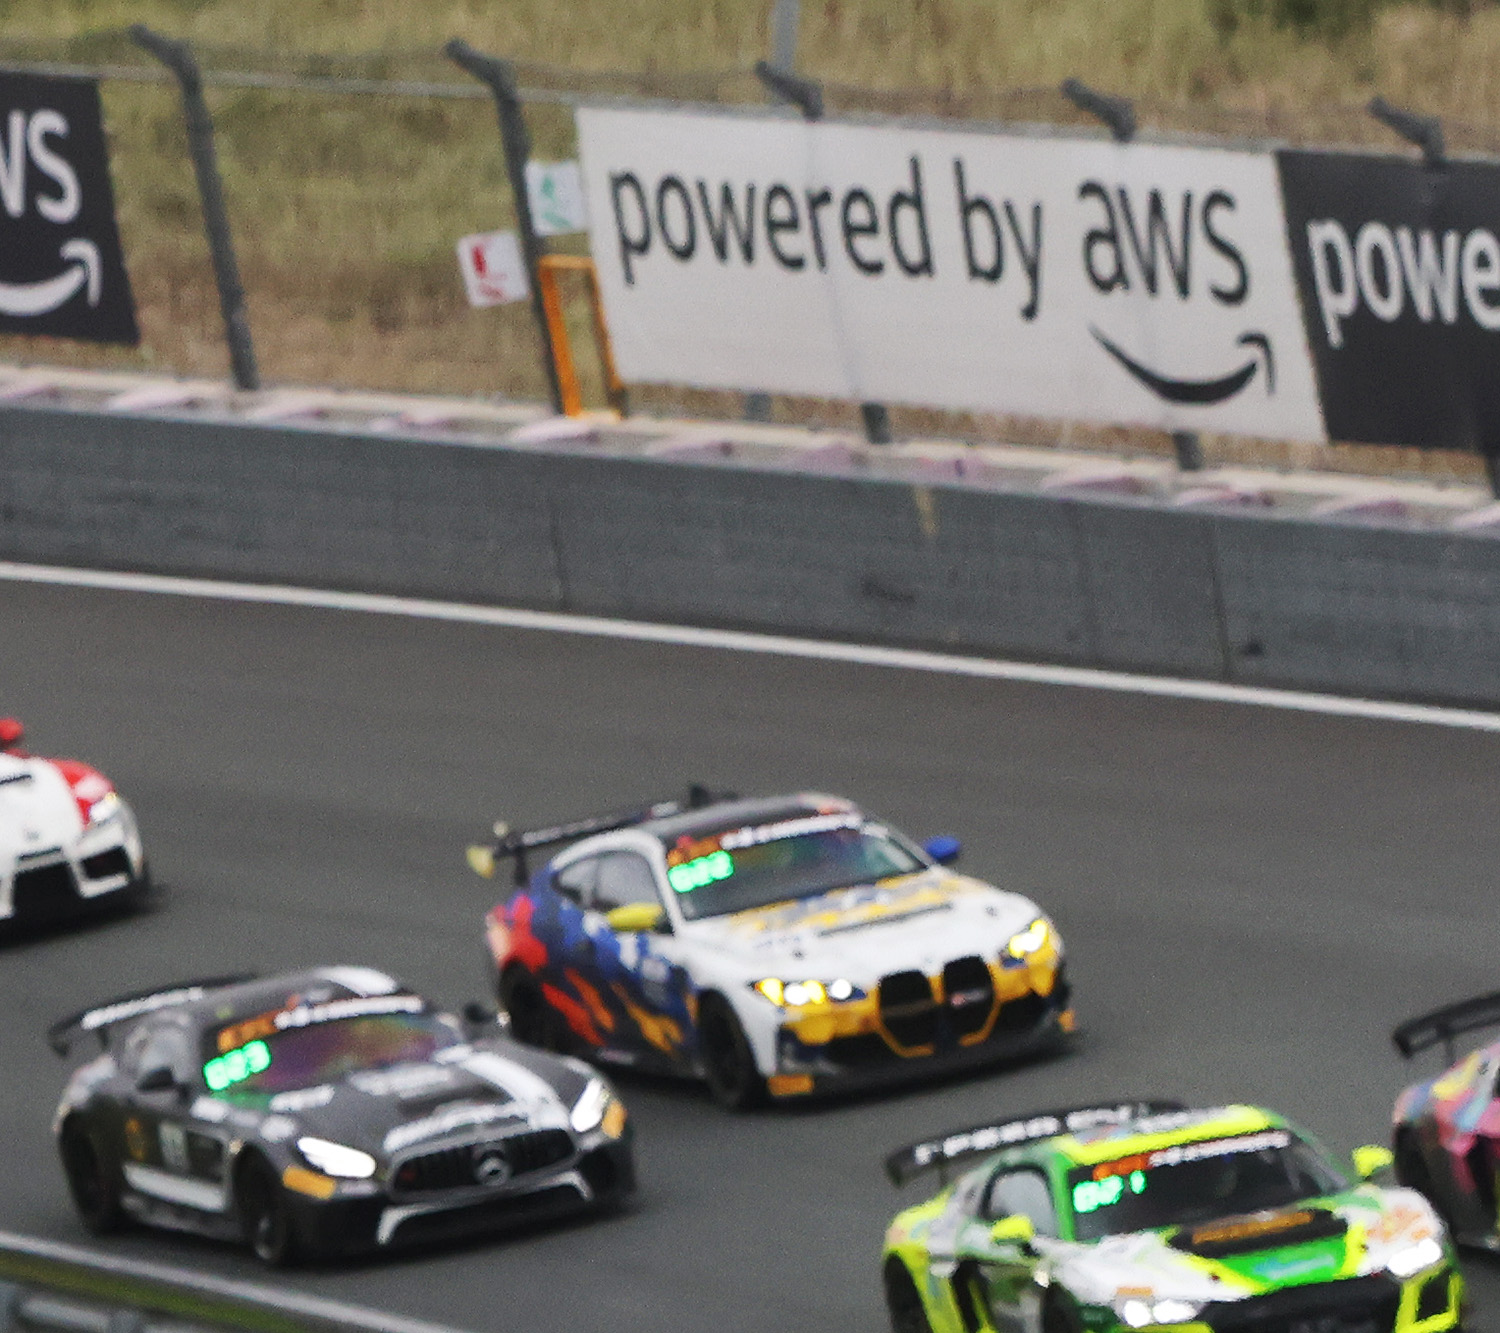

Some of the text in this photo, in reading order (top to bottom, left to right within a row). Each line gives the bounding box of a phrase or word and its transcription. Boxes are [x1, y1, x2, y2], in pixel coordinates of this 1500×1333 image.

[609, 155, 1250, 320] powered by aws
